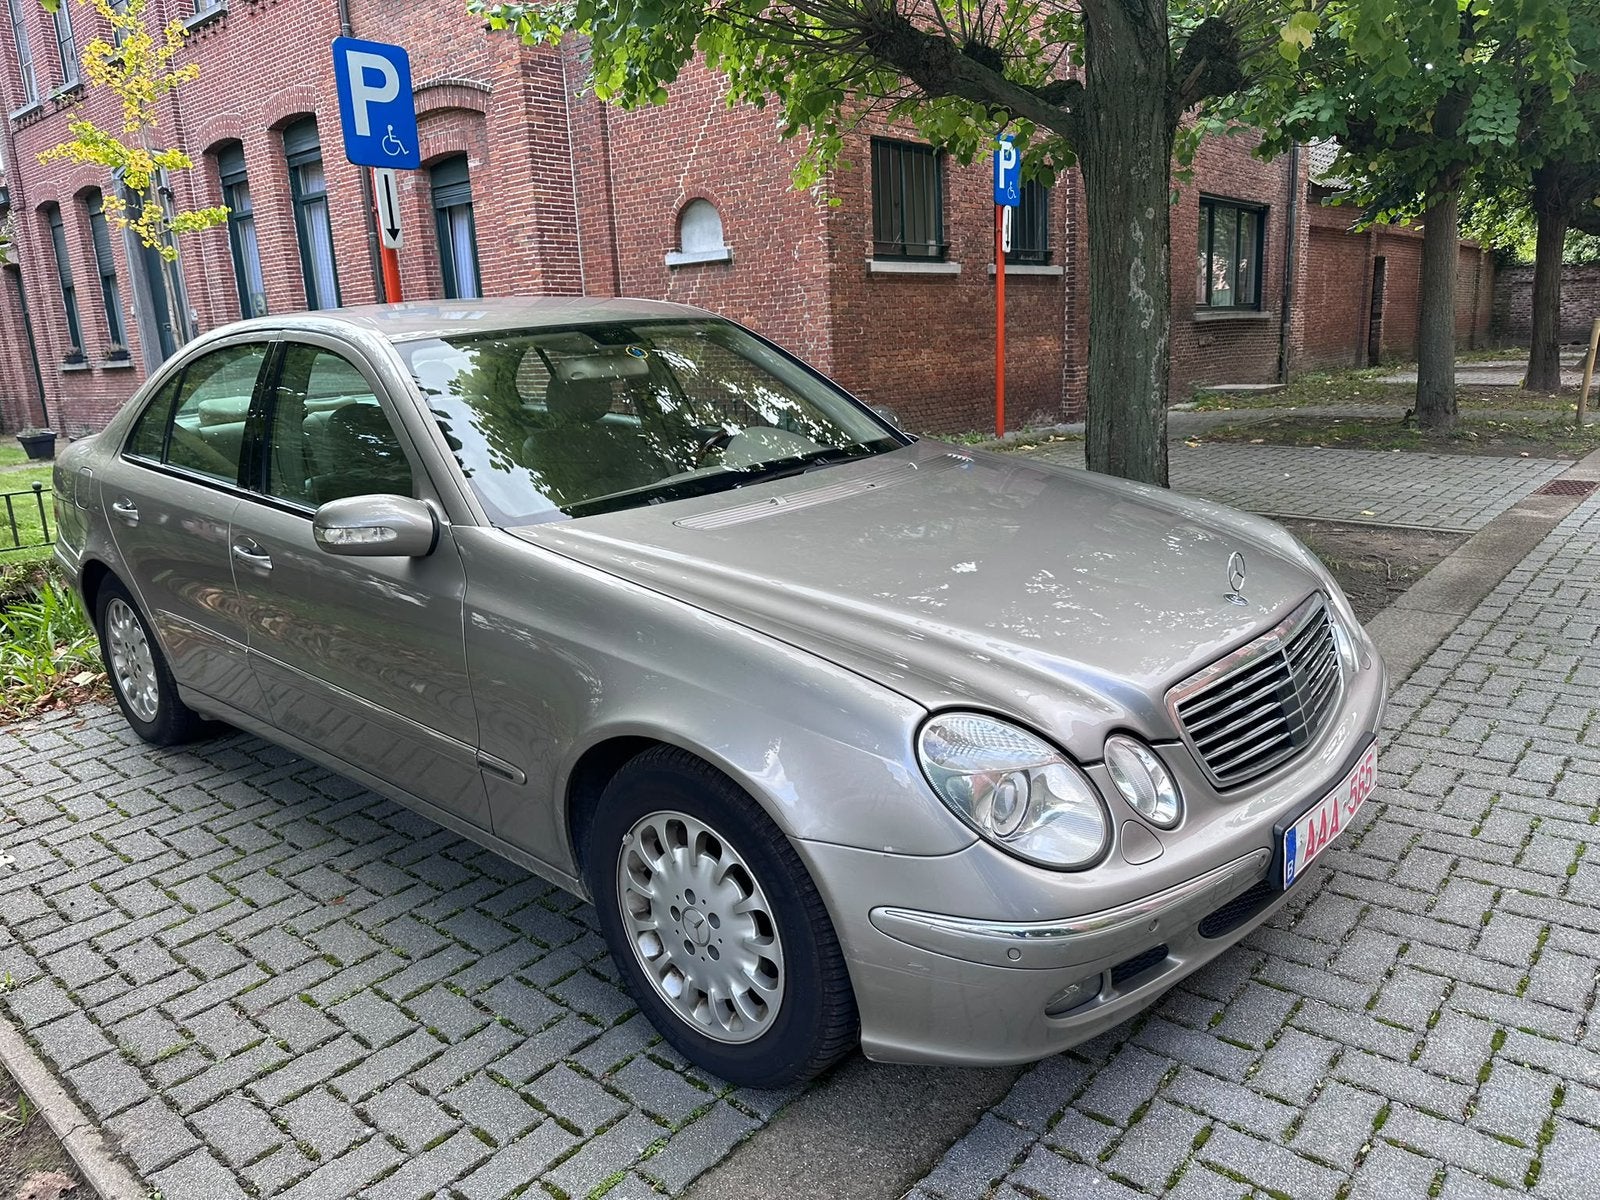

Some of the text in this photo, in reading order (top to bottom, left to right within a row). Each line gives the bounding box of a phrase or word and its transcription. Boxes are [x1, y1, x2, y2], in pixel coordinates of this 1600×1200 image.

[346, 50, 400, 136] P
[999, 140, 1017, 189] P
[1287, 860, 1294, 880] B
